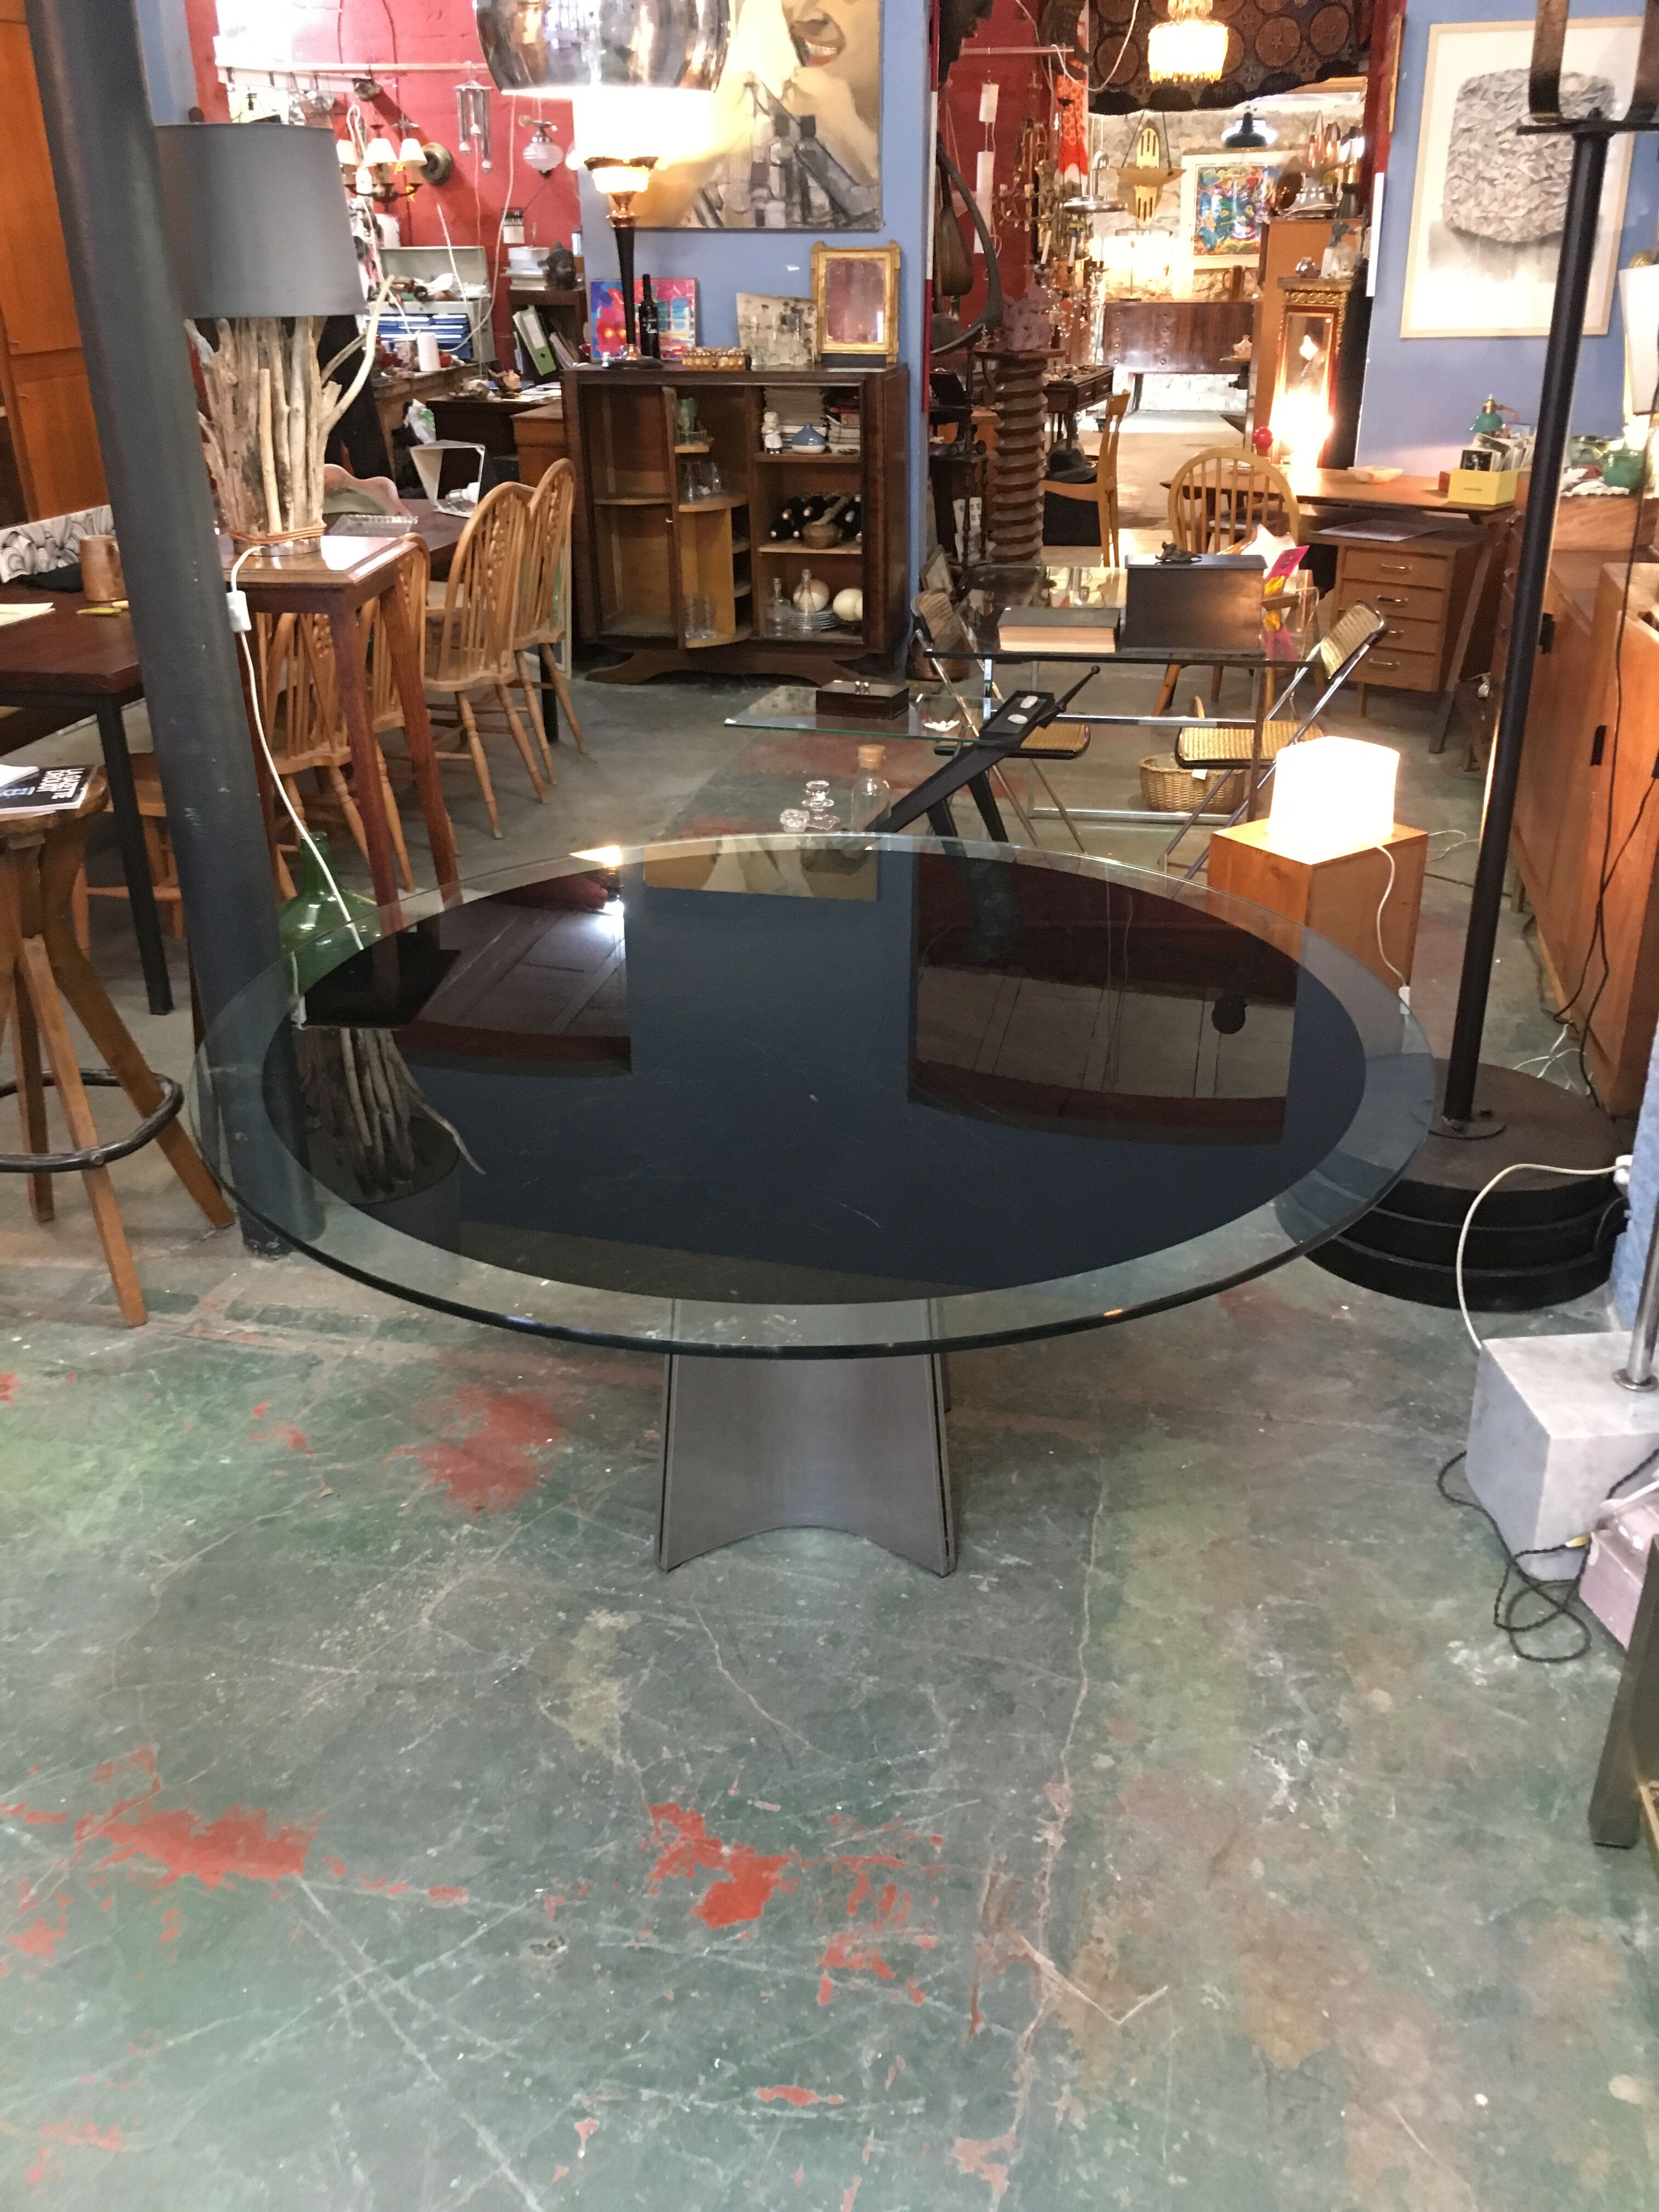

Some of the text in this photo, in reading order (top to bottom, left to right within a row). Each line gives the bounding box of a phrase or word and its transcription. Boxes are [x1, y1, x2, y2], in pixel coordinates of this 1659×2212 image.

[36, 770, 66, 792] DROUOT
[52, 768, 85, 799] LA GAZETTE
